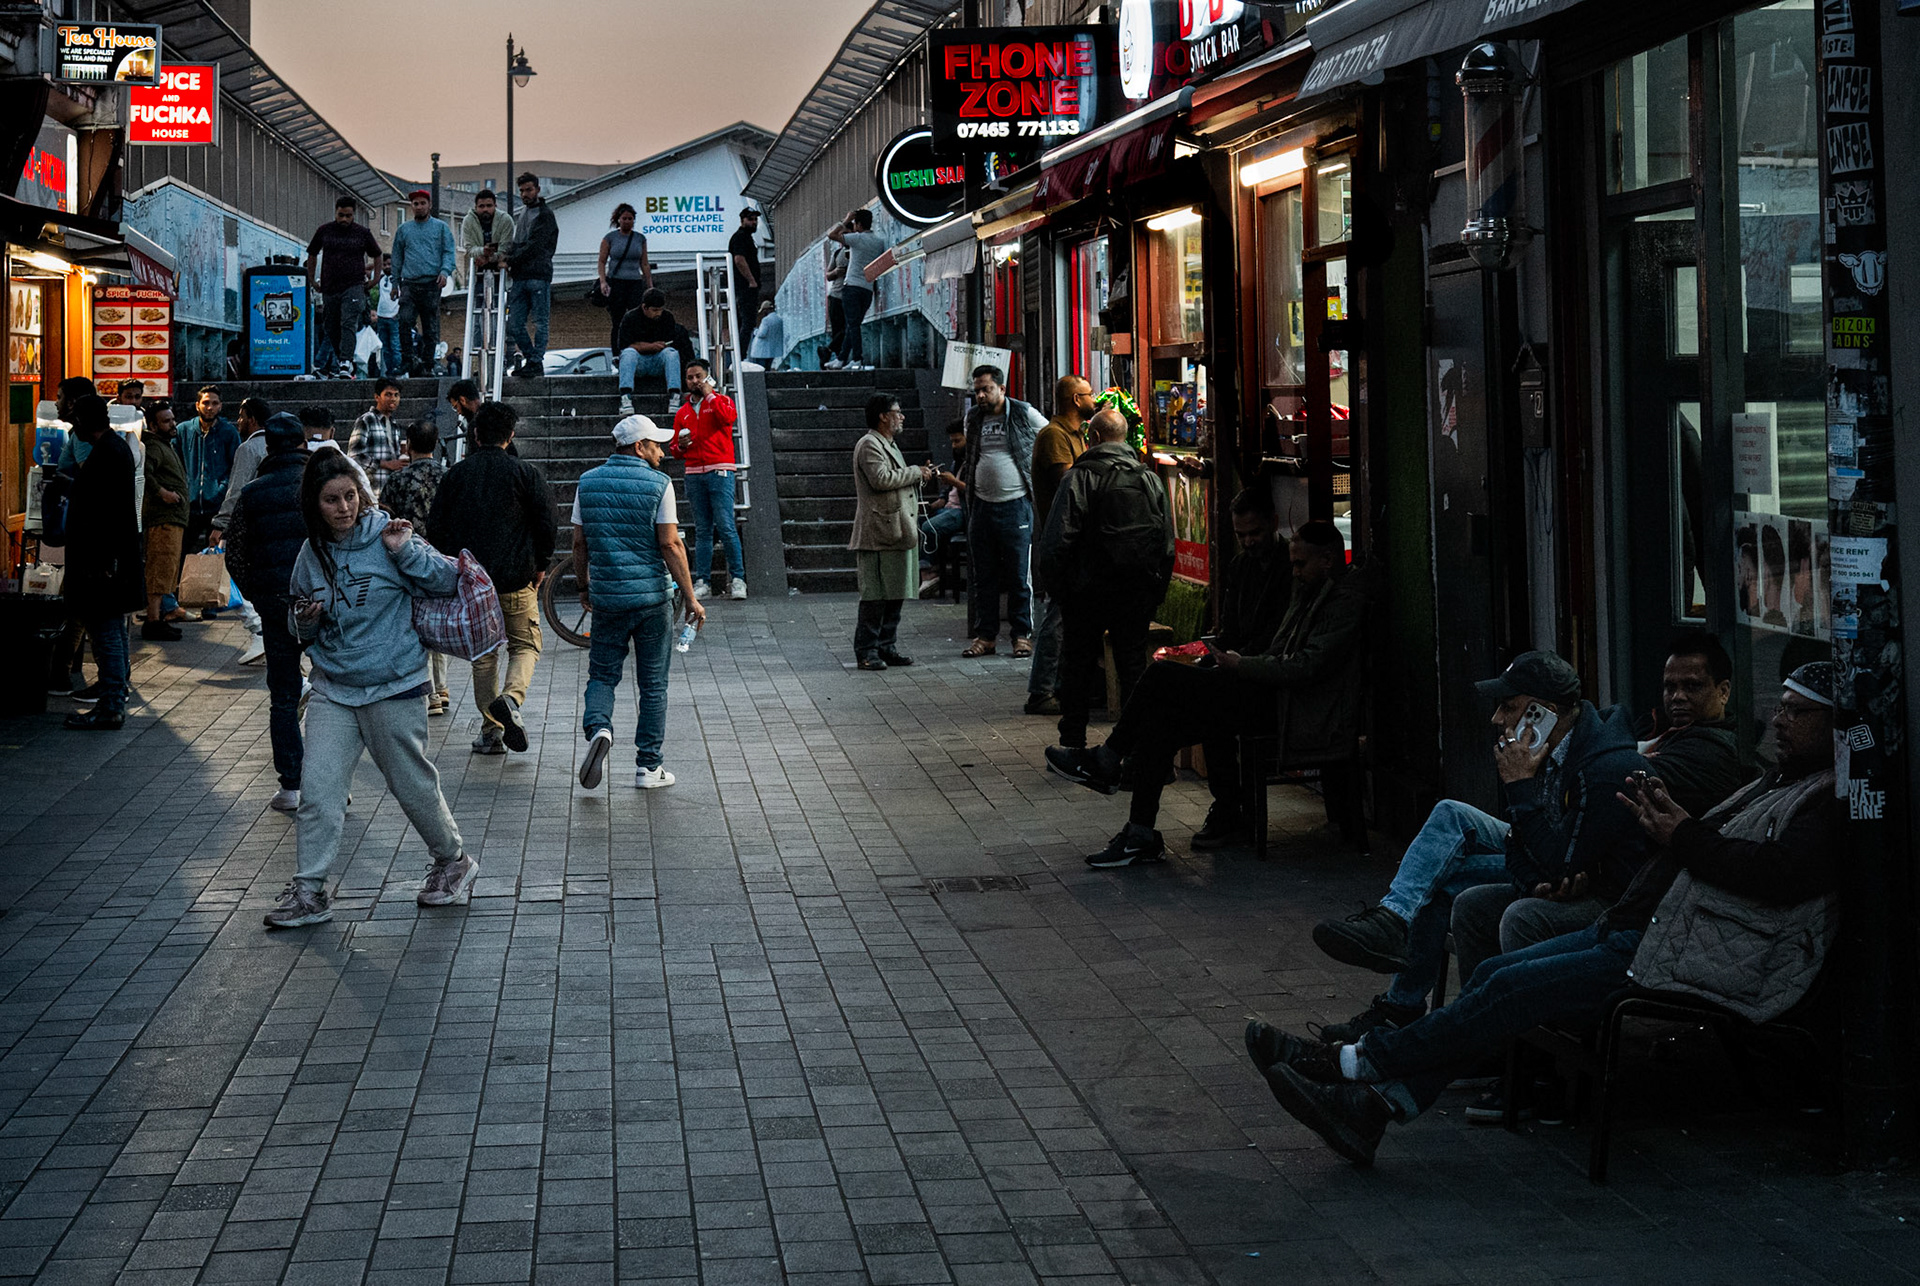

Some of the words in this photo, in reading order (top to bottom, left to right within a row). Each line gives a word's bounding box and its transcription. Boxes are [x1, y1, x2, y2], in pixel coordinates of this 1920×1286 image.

[57, 25, 94, 47] Tea
[93, 27, 157, 48] House
[83, 48, 115, 56] SPECIALIST
[1190, 36, 1217, 73] SNACK
[1221, 24, 1239, 58] BAR
[143, 72, 201, 90] PICE
[959, 80, 1080, 117] ZONE
[130, 105, 211, 124] FUCHKA
[152, 129, 189, 139] HOUSE
[957, 121, 1010, 138] 07465
[1017, 120, 1080, 136] 771133
[890, 169, 935, 190] DESHI
[646, 197, 668, 213] BE
[675, 196, 725, 212] WELL
[651, 214, 724, 223] WHITECHAPEL
[643, 225, 682, 234] SPORTS
[684, 225, 724, 233] CENTRE
[106, 289, 129, 298] SPICE
[1834, 319, 1872, 331] BIZOK
[1846, 548, 1870, 556] RENT
[1850, 778, 1869, 794] WE
[1850, 790, 1886, 807] HATE
[1850, 804, 1883, 819] EINE
